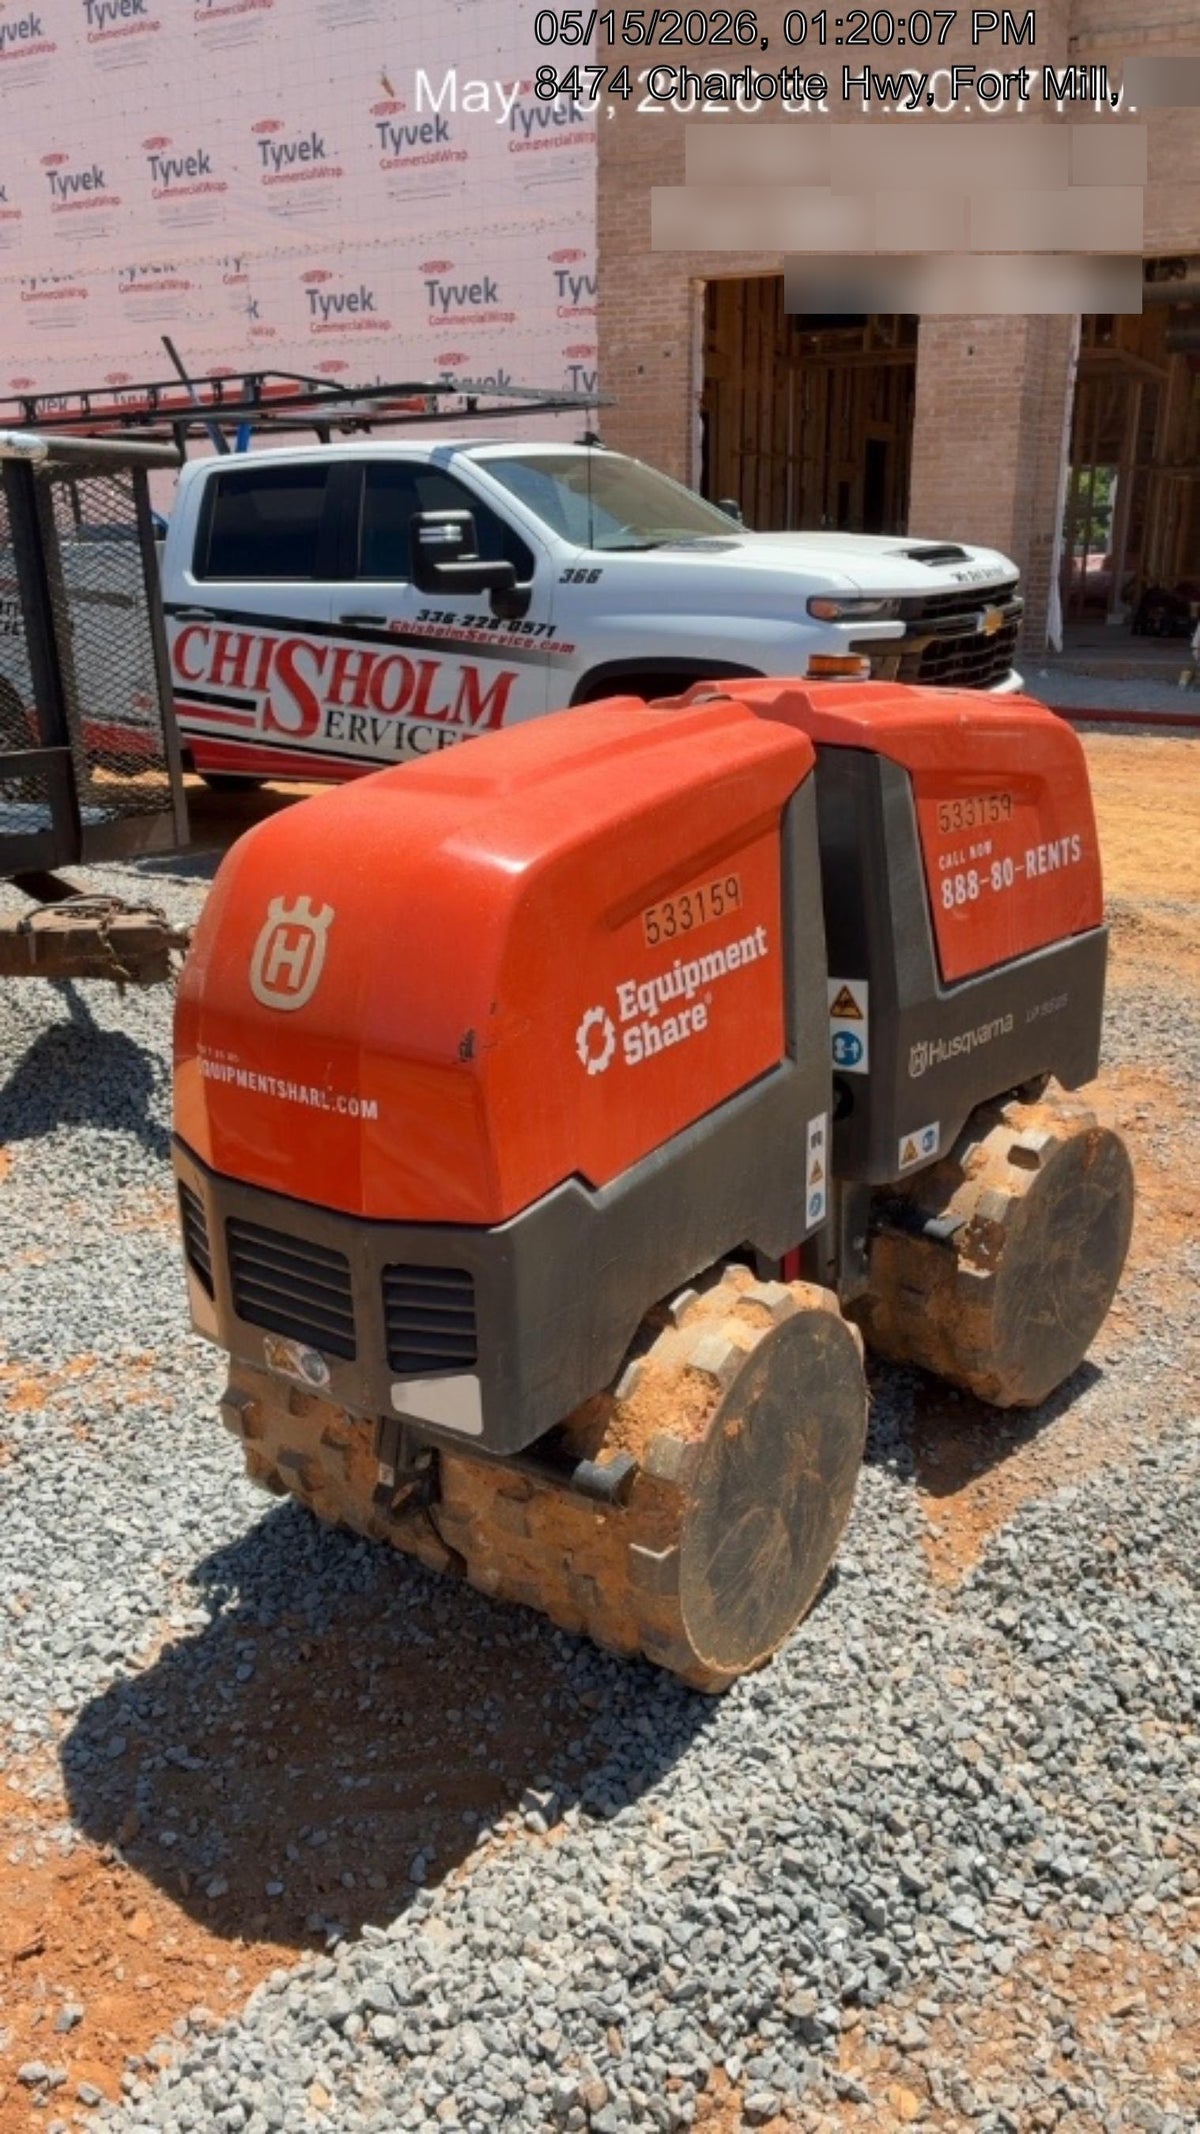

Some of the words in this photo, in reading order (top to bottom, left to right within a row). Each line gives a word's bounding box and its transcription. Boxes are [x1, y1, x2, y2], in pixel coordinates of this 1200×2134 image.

[258, 132, 326, 172] Tyvek
[376, 114, 450, 156] Tyvek
[46, 164, 106, 200] Tyvek
[147, 149, 212, 188] Tyvek
[305, 285, 374, 321] Tyvek
[424, 275, 499, 314] Tyvek
[559, 568, 603, 585] 366
[173, 624, 520, 738] CHISHOLM
[939, 794, 1011, 833] 533159
[941, 833, 1081, 910] 888-80-RENTS
[645, 876, 739, 945] 533159
[616, 924, 769, 1022] Equipment
[929, 1013, 1014, 1066] Husqvarna
